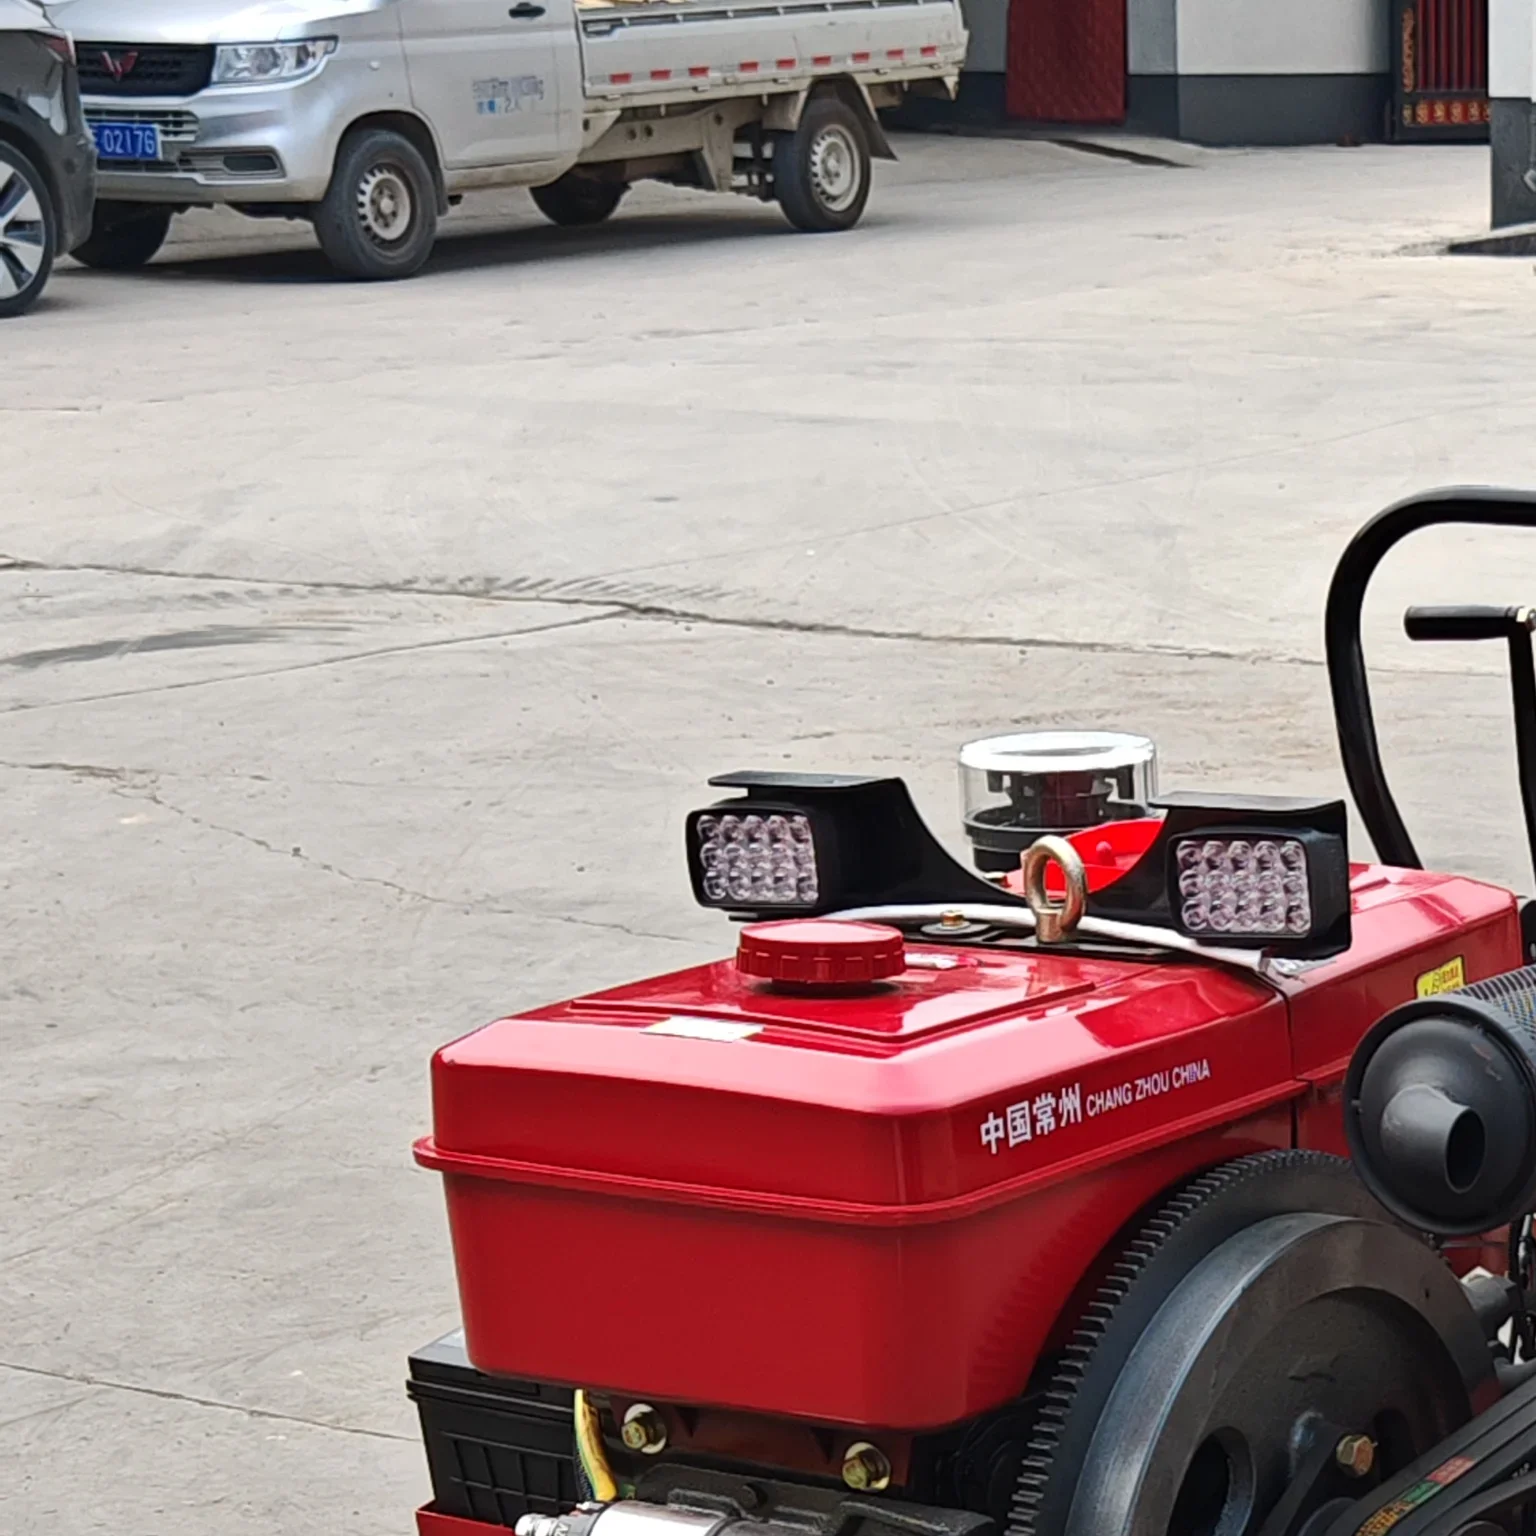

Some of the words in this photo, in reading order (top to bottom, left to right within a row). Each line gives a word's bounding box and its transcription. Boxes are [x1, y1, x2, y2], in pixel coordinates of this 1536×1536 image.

[91, 128, 156, 155] 02176
[980, 1083, 1082, 1154] 中国常州
[1086, 1082, 1133, 1117] CHANG
[1134, 1070, 1171, 1101] ZHOU
[1171, 1058, 1211, 1089] CHINA
